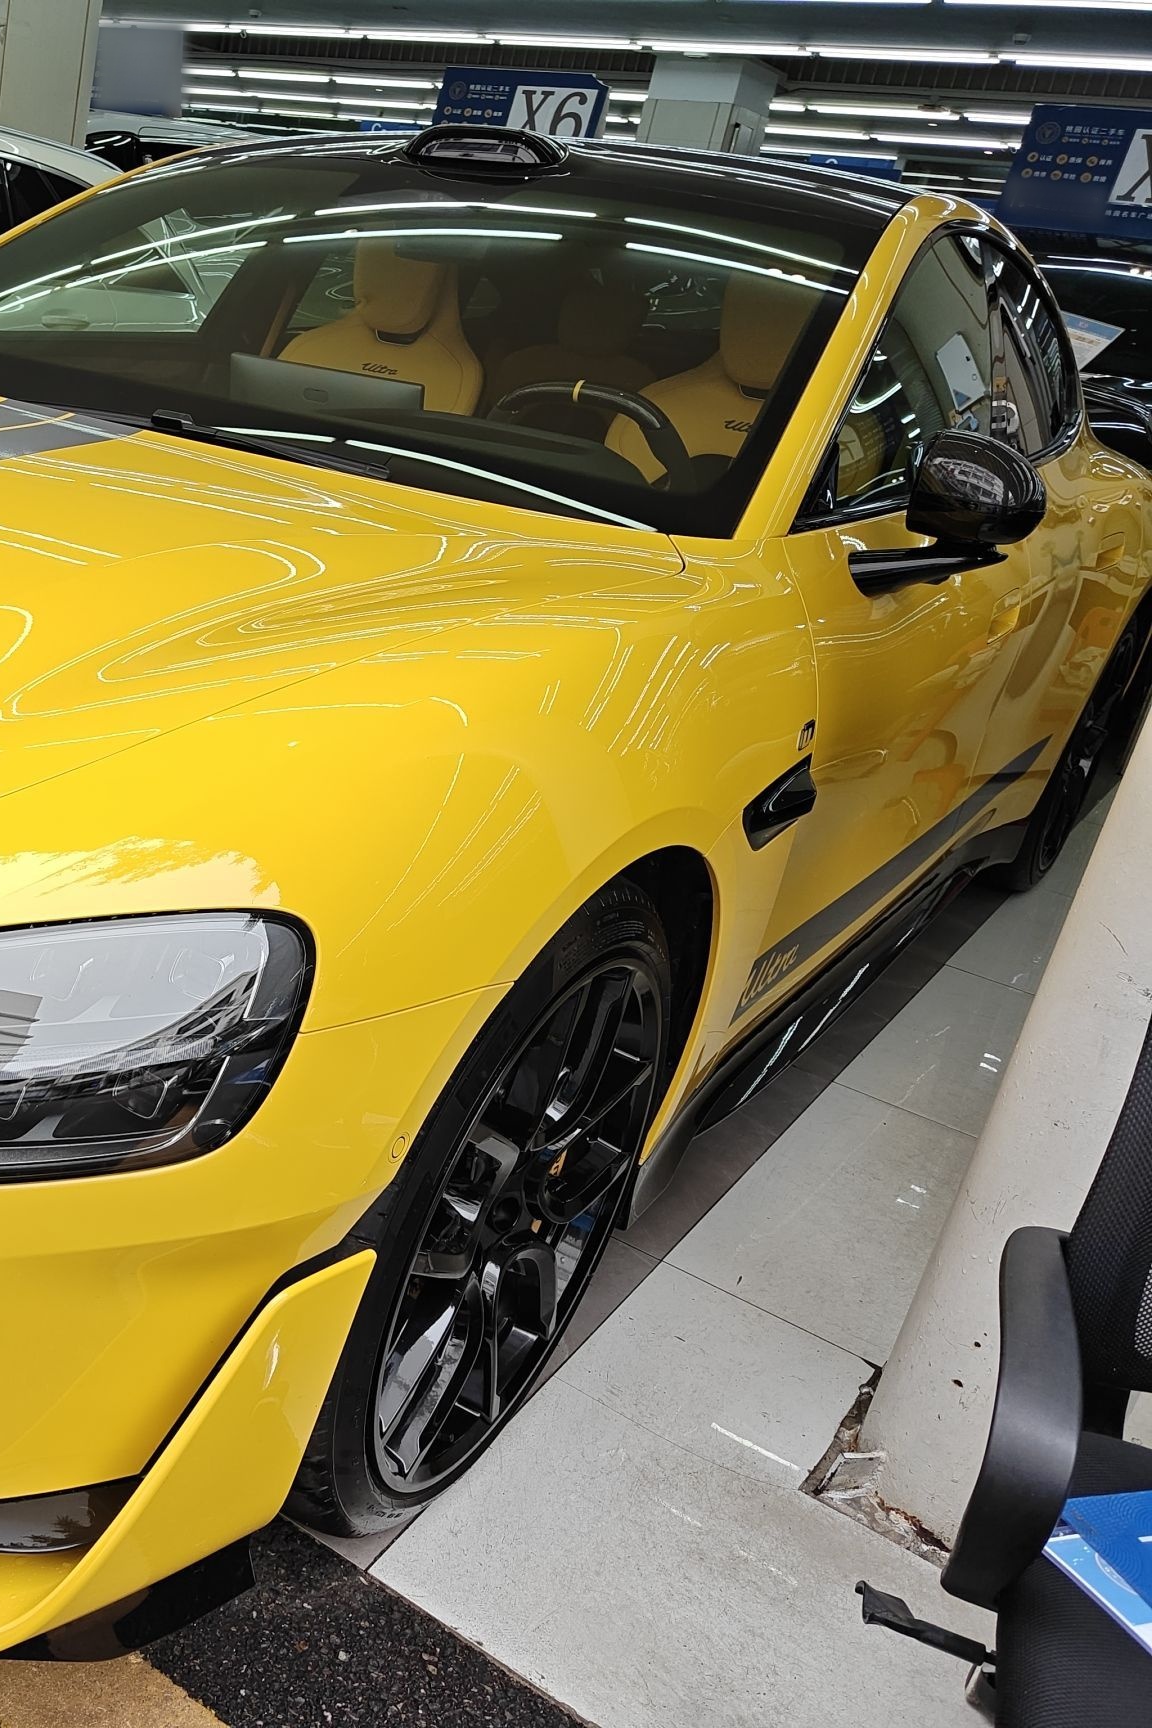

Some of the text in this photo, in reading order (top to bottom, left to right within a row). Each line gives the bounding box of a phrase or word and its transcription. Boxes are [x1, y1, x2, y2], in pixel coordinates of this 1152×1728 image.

[521, 89, 588, 138] X6
[361, 362, 399, 375] Ultra
[739, 943, 800, 1008] Ultra
